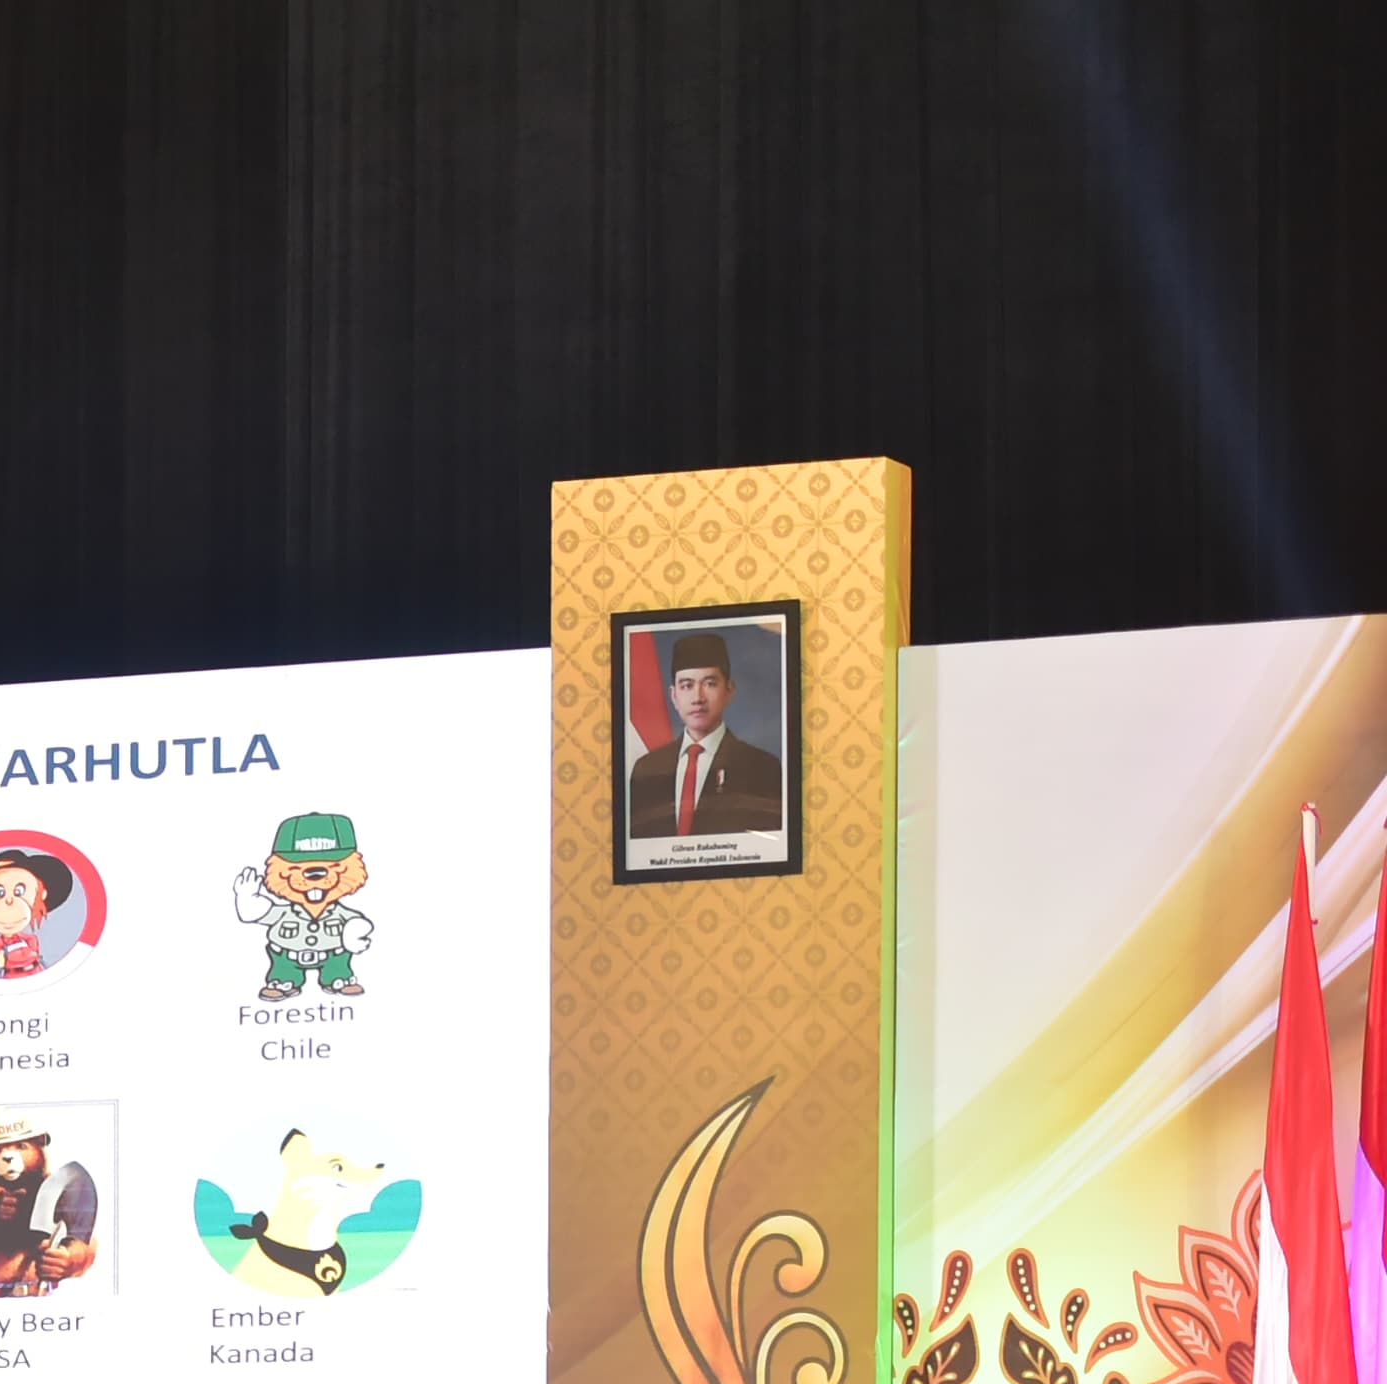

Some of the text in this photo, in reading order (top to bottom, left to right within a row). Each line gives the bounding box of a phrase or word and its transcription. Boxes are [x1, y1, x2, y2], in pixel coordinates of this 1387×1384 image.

[238, 1000, 356, 1026] Forestin
[261, 1038, 332, 1061] Chile
[22, 1312, 85, 1334] Bear
[211, 1305, 305, 1328] Ember
[211, 1341, 314, 1365] Kanada
